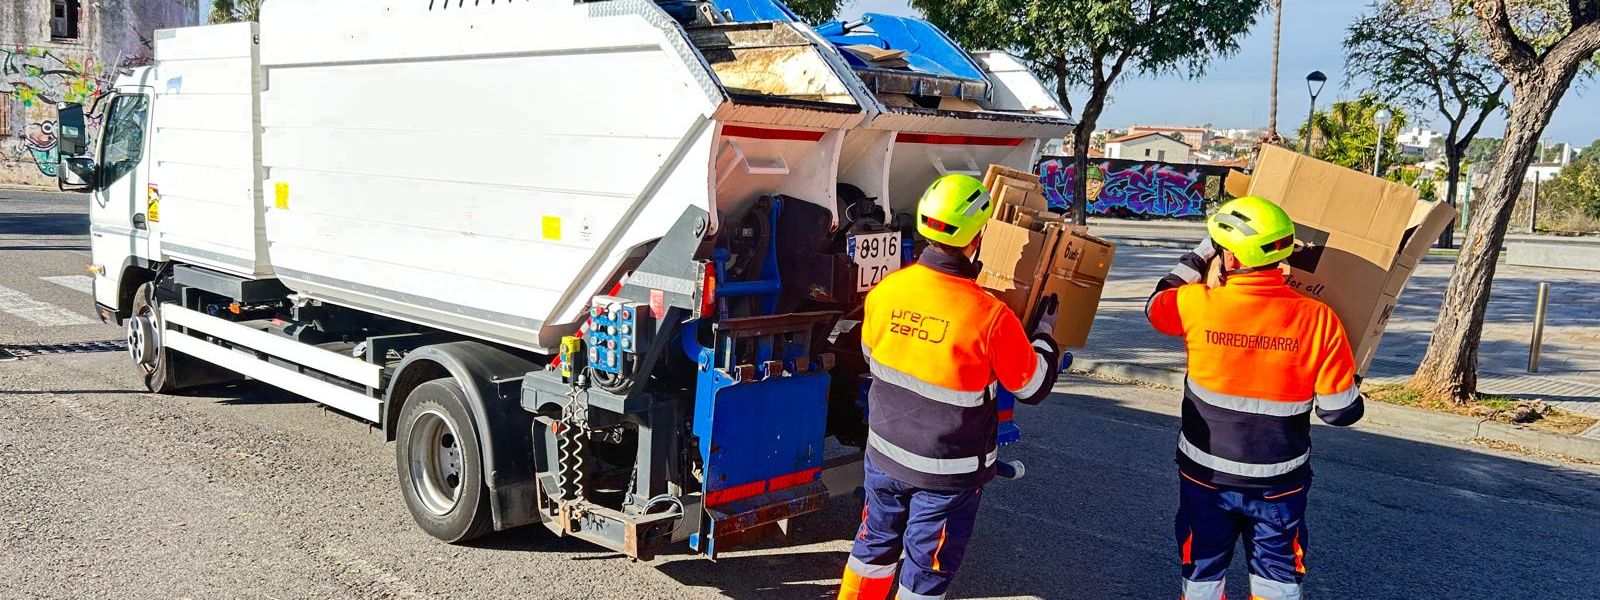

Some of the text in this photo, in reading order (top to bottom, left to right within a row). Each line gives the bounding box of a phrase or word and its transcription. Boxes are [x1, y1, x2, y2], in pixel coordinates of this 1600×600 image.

[860, 236, 898, 259] 8916
[1305, 283, 1325, 296] all
[891, 309, 922, 323] pre
[890, 322, 929, 341] zero
[1205, 329, 1299, 353] TORREDEMBARRA
